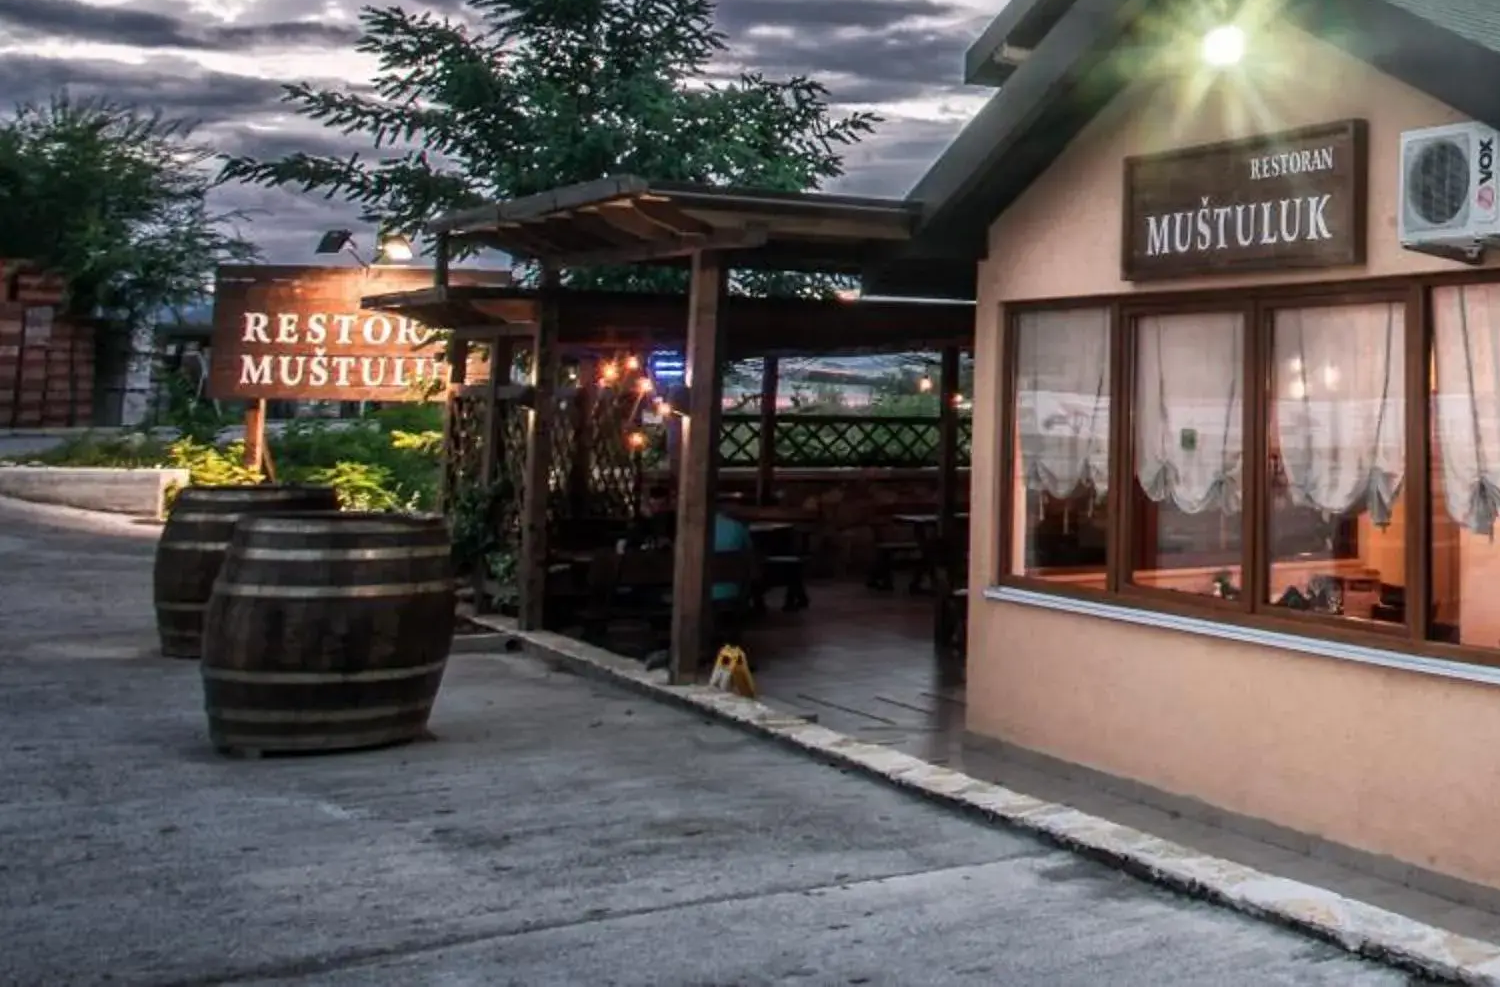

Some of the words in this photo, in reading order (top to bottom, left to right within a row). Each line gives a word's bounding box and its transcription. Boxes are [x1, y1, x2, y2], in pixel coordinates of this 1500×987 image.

[1250, 146, 1334, 180] RESTORAN
[1478, 137, 1494, 185] VOX
[1146, 194, 1333, 256] MUŠTULUK
[242, 312, 447, 345] RESTOR
[239, 346, 450, 387] MUŠTULU
